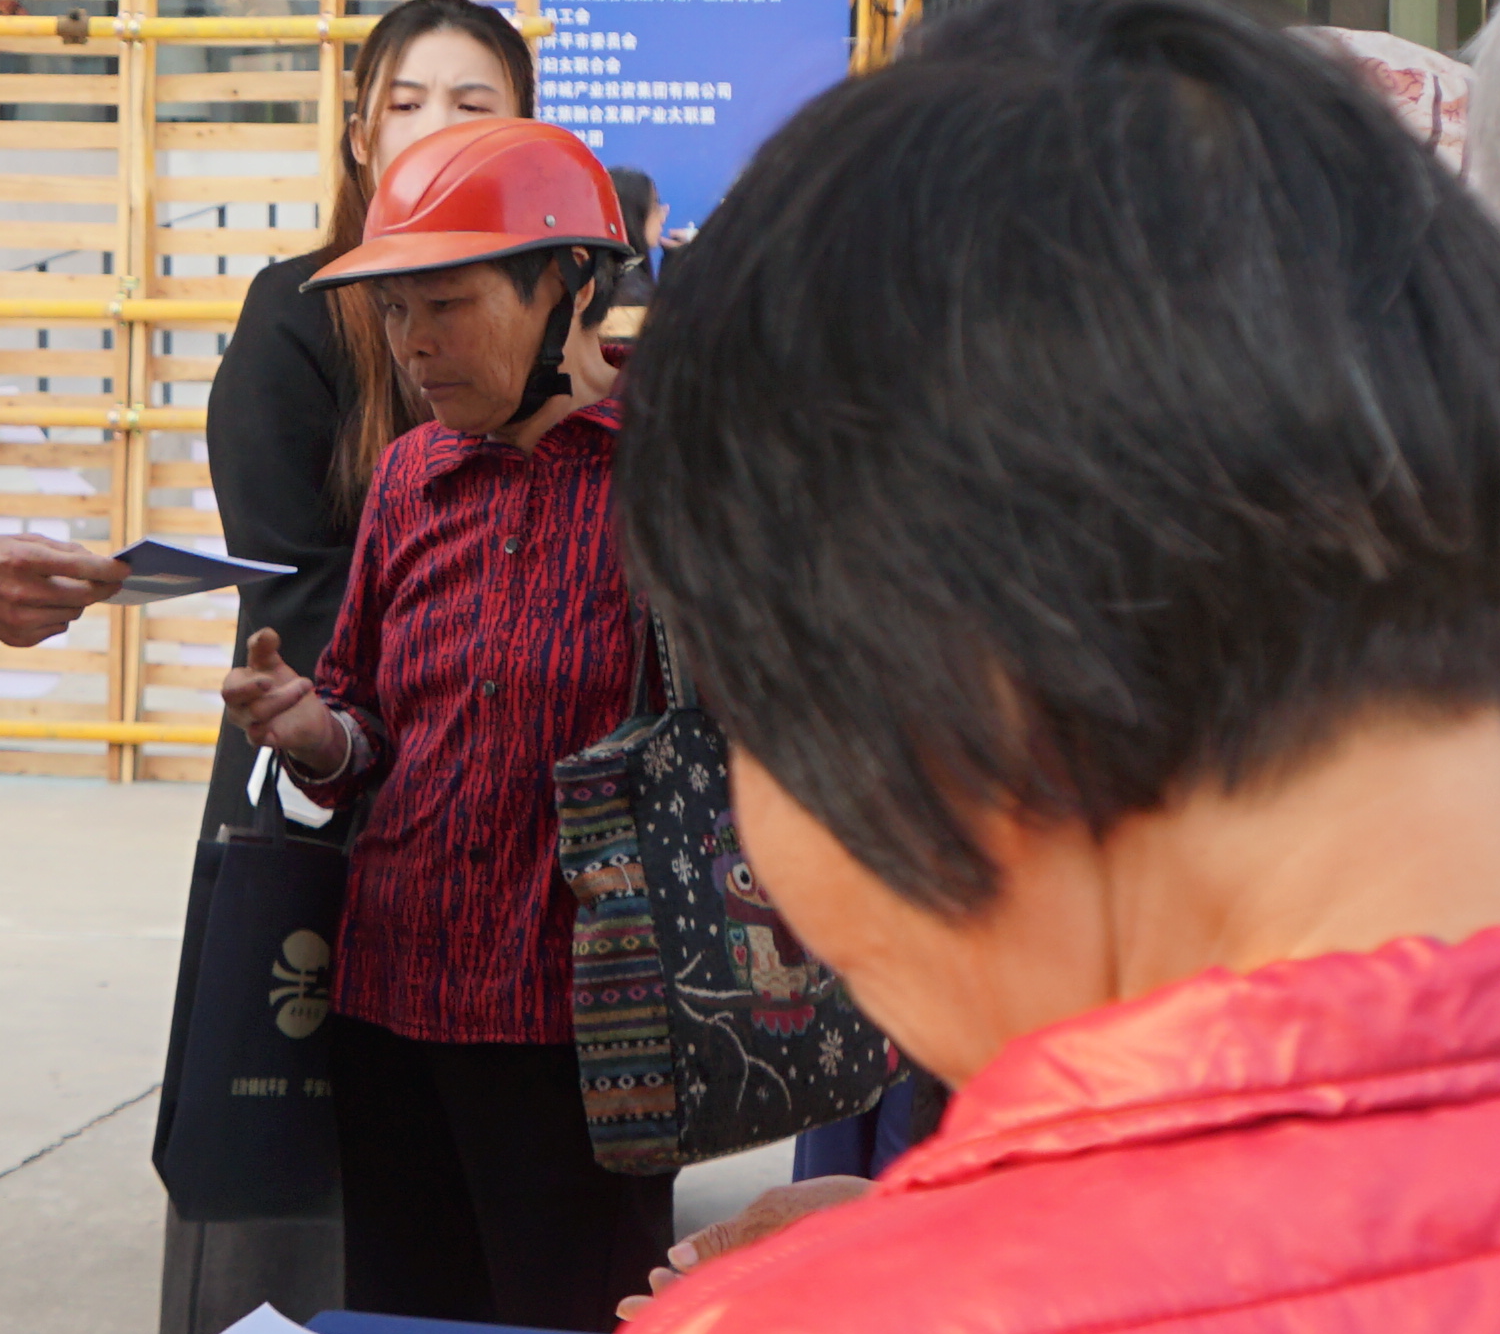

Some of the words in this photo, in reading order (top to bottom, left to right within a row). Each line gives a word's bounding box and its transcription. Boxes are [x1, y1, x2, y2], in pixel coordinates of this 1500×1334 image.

[538, 56, 622, 75] 妇女联合会
